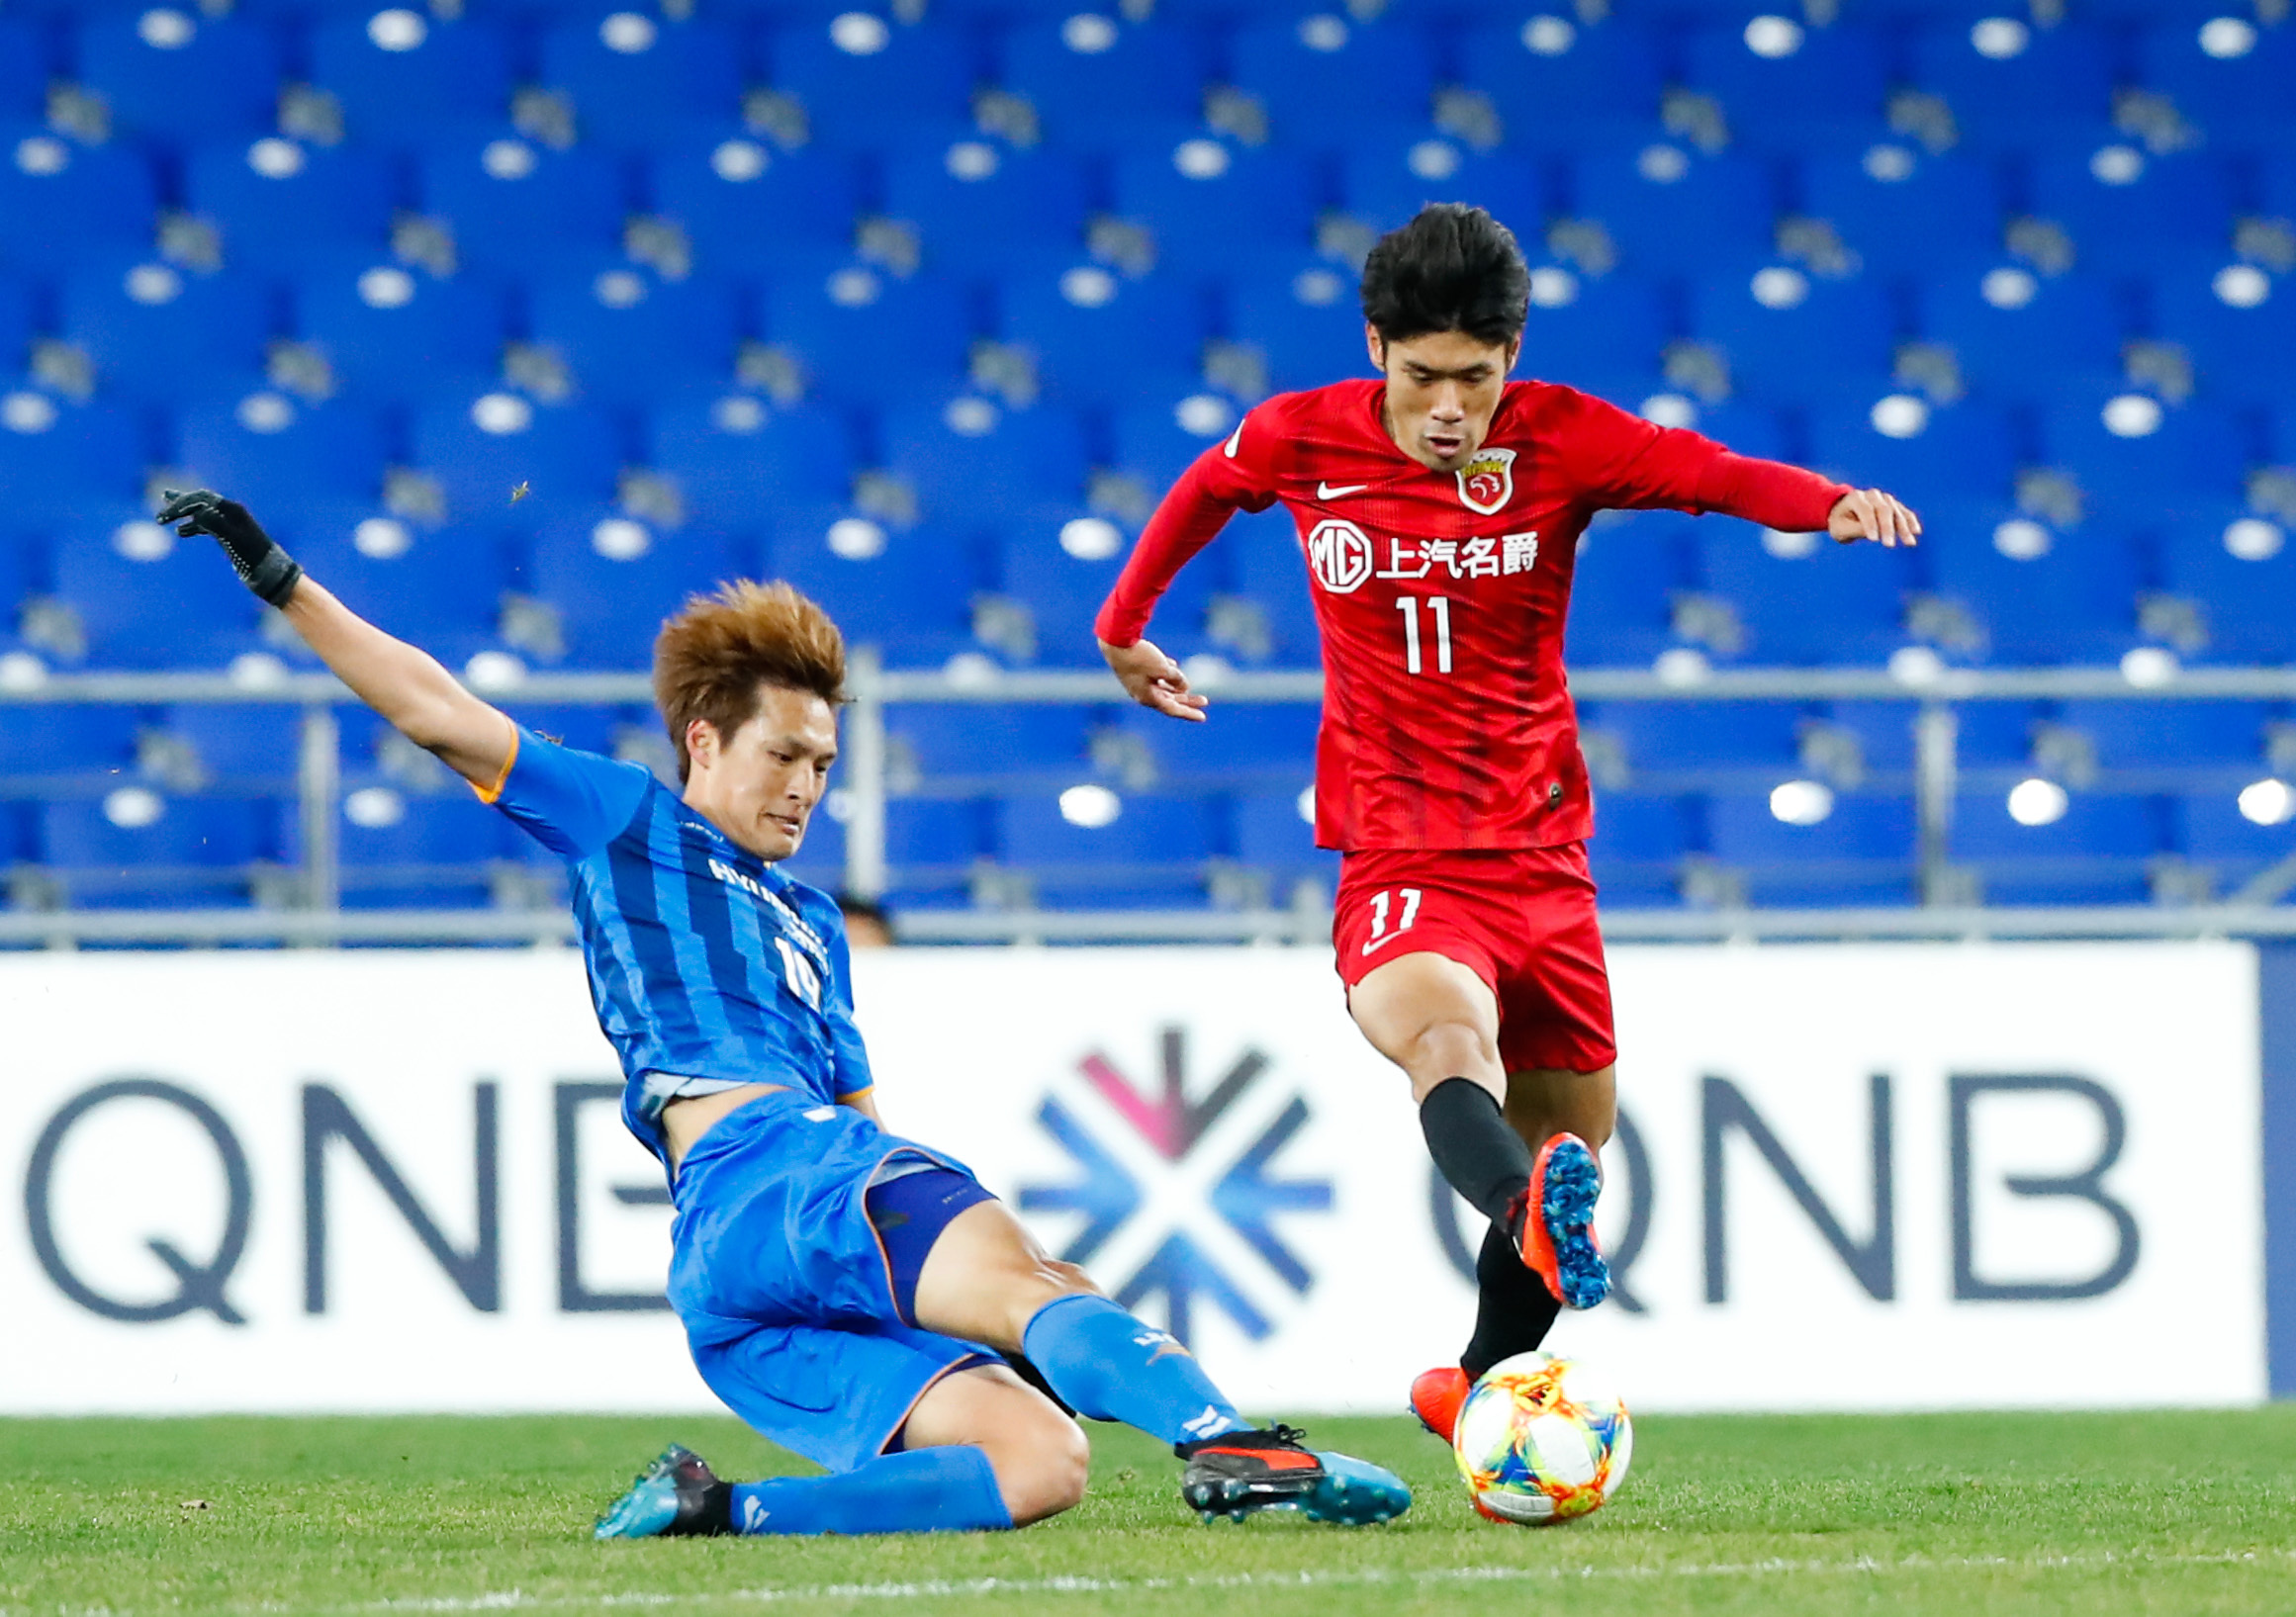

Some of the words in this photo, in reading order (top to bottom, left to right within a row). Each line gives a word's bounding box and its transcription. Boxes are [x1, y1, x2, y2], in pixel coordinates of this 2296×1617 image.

[1310, 525, 1365, 586] MG
[1376, 531, 1538, 580] 上汽名爵
[1395, 595, 1452, 674] 11
[1369, 888, 1423, 940] 11
